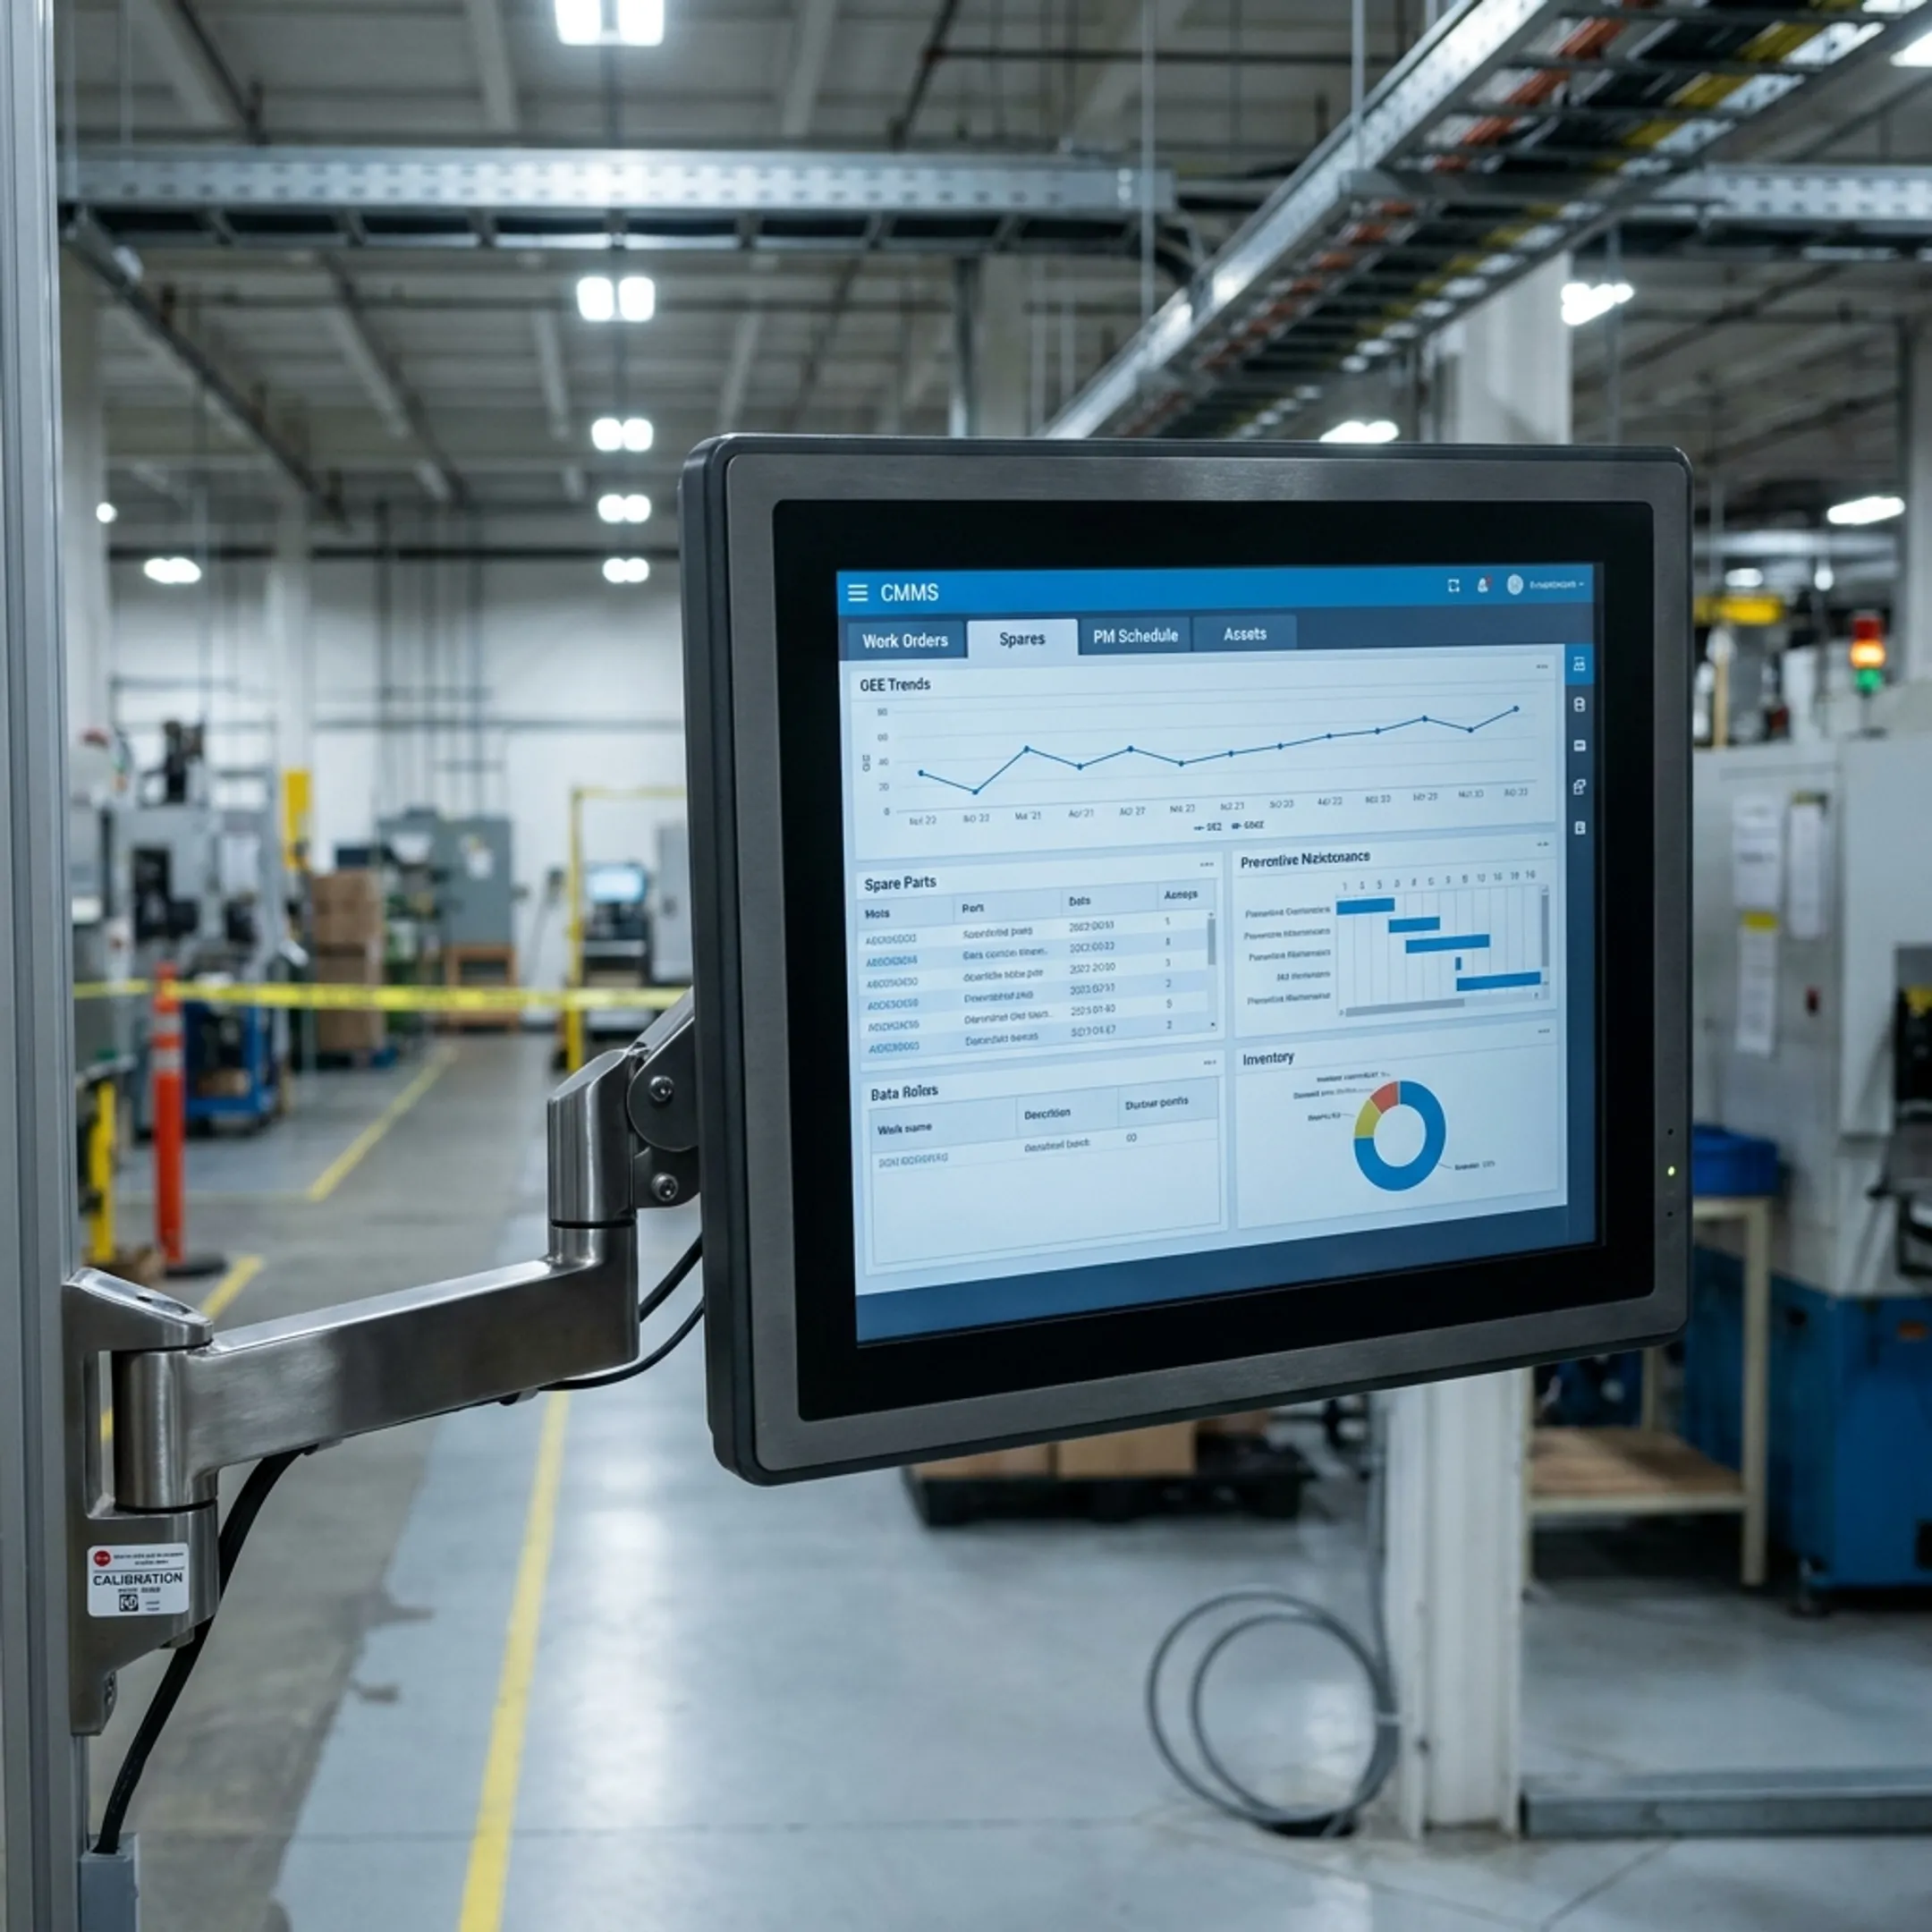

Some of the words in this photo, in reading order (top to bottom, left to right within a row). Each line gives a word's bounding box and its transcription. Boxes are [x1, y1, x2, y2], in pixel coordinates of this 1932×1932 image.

[880, 583, 939, 602] CMMS
[862, 633, 899, 648] Work
[902, 632, 948, 648] Orders
[1000, 631, 1046, 648] Spares
[1094, 630, 1114, 644] PM
[1119, 627, 1179, 643] Schedule
[1224, 627, 1267, 641] Assets
[889, 677, 931, 691] Trends
[864, 877, 902, 894] Spare
[1243, 1052, 1294, 1064] Inventory
[93, 1572, 182, 1586] CALIBRATION
